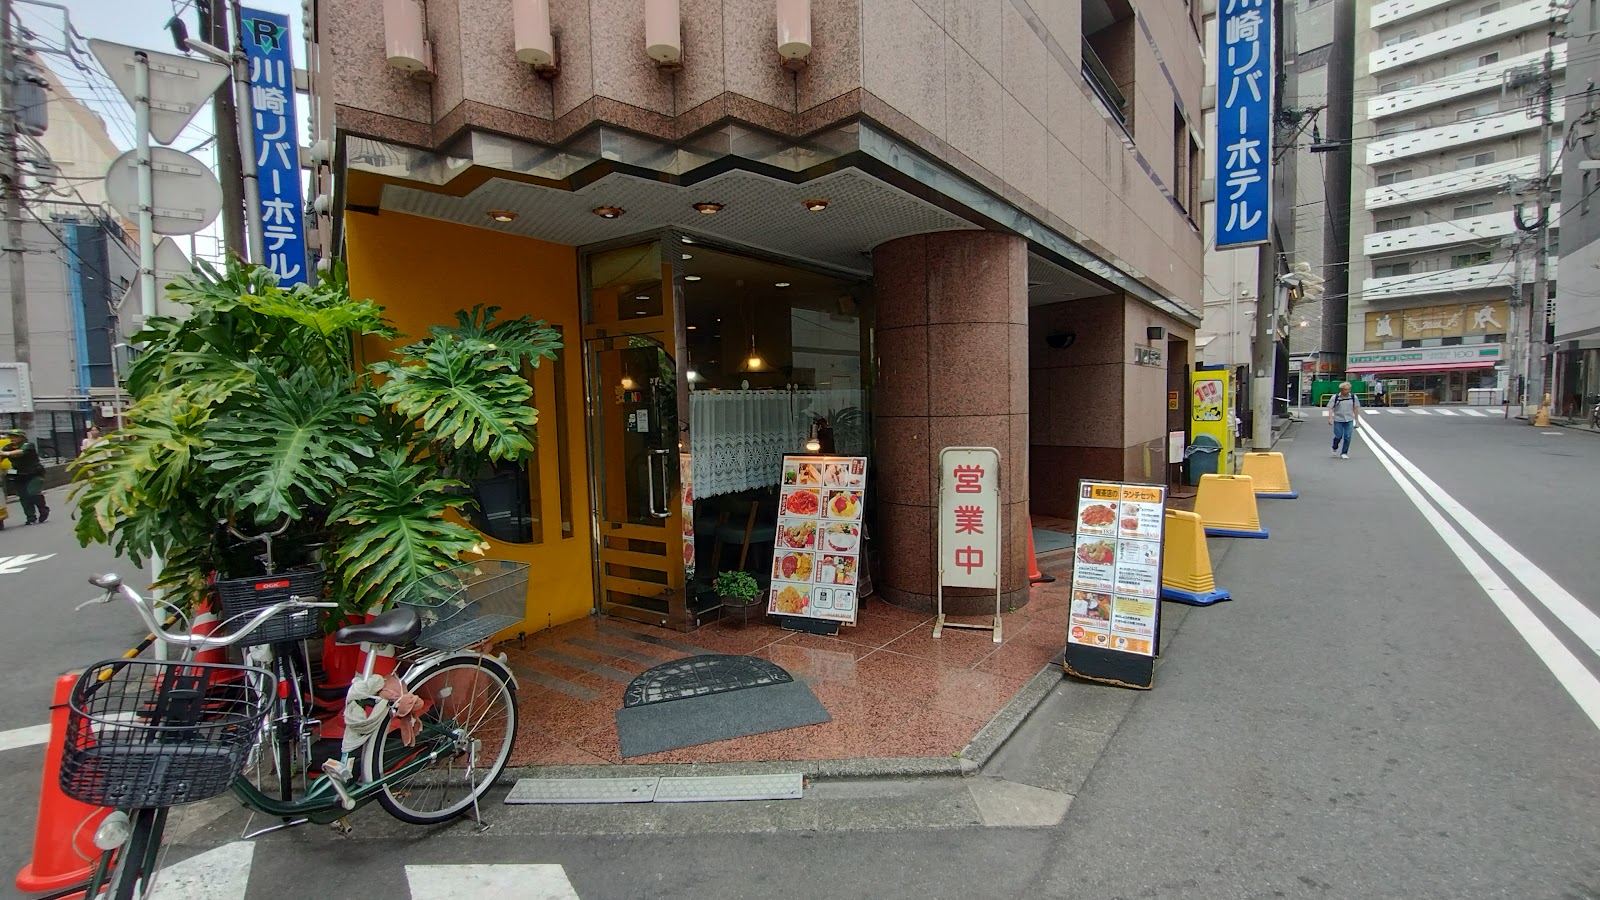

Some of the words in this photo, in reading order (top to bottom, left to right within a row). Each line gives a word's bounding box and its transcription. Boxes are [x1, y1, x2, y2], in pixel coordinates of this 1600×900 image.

[250, 56, 301, 281] 川崎リバーホテル
[1195, 382, 1216, 402] 100
[953, 464, 985, 575] 営業中
